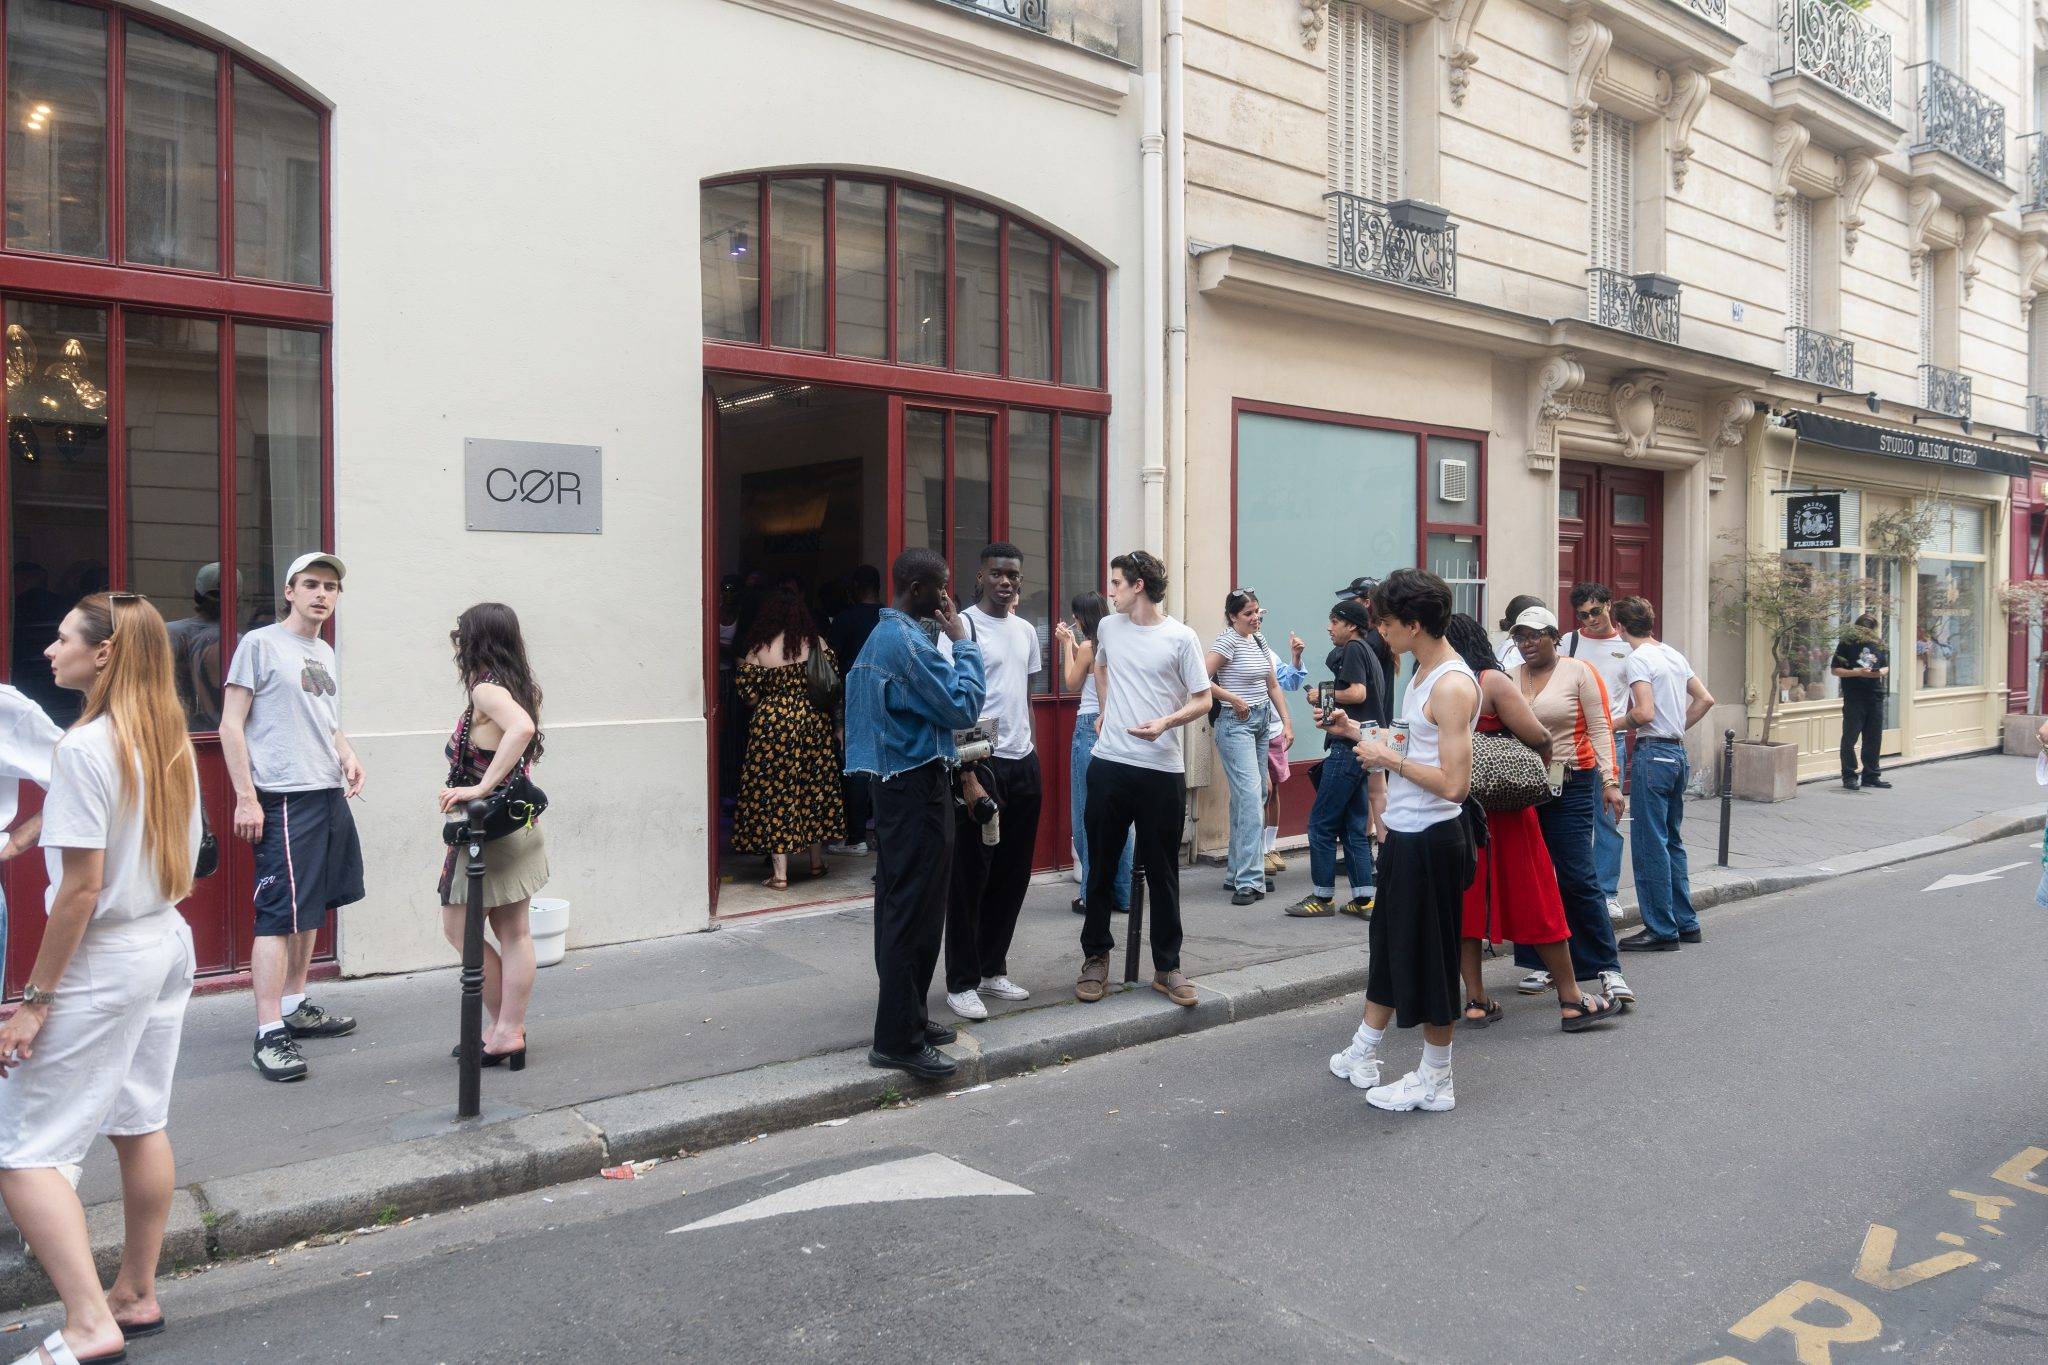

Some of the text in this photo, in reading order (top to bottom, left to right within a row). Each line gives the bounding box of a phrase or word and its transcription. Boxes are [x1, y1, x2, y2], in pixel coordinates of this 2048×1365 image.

[1880, 434, 1978, 466] STUDIO MAISON CIERO
[486, 467, 581, 505] CØR
[1793, 510, 1802, 534] STUDIO
[1802, 501, 1828, 510] MAISON
[1793, 540, 1834, 548] FLEURISTE
